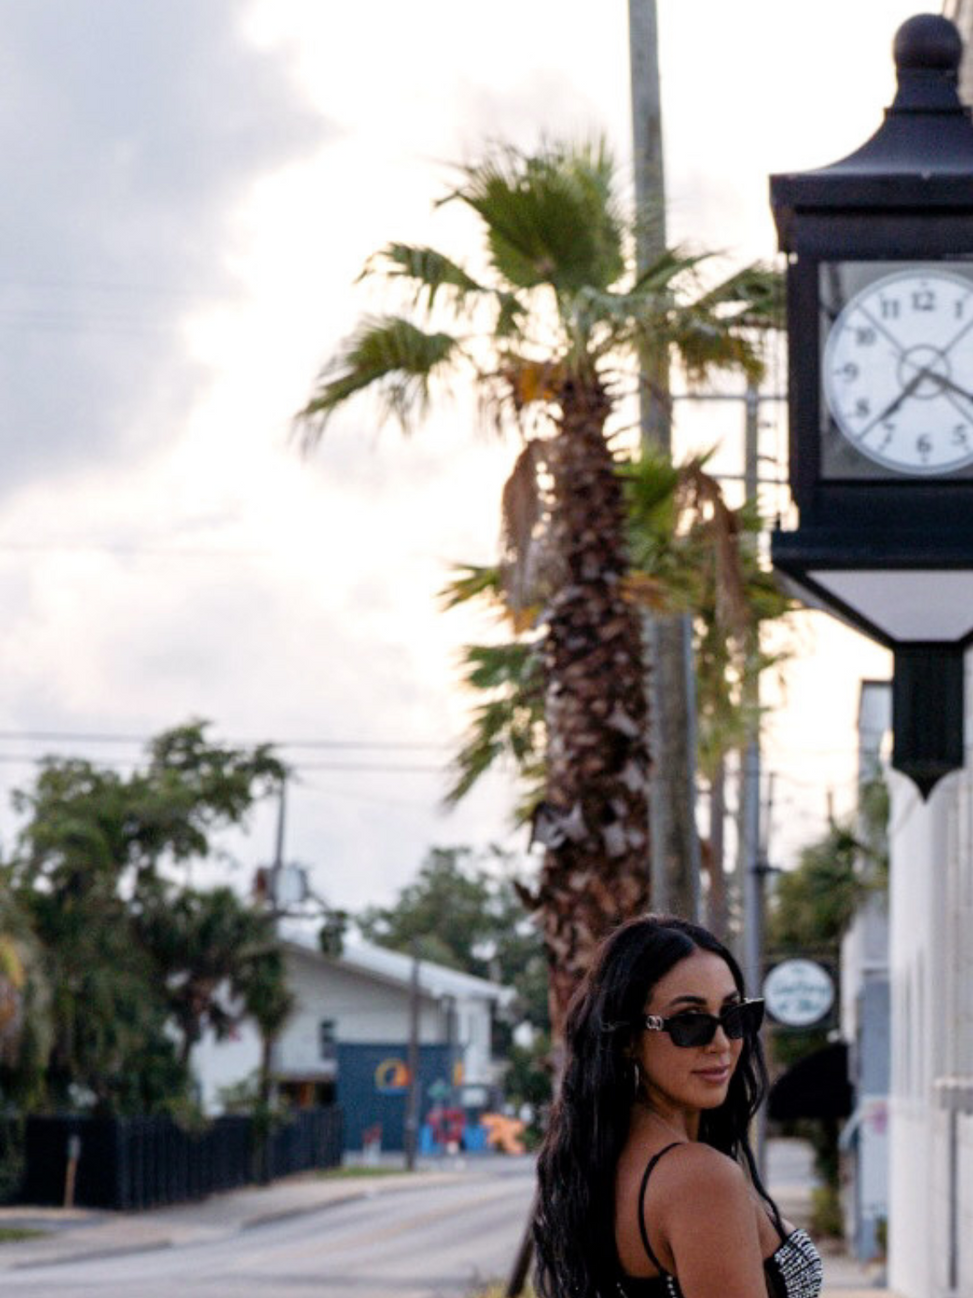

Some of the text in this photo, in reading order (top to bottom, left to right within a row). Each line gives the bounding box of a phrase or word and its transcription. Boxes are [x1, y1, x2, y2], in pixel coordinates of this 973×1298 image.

[882, 300, 900, 319] 11
[912, 292, 934, 311] 12
[954, 301, 963, 318] 1
[856, 327, 876, 346] 10
[844, 363, 859, 382] 9
[856, 399, 869, 416] 8
[917, 433, 931, 453] 6
[953, 425, 967, 444] 5
